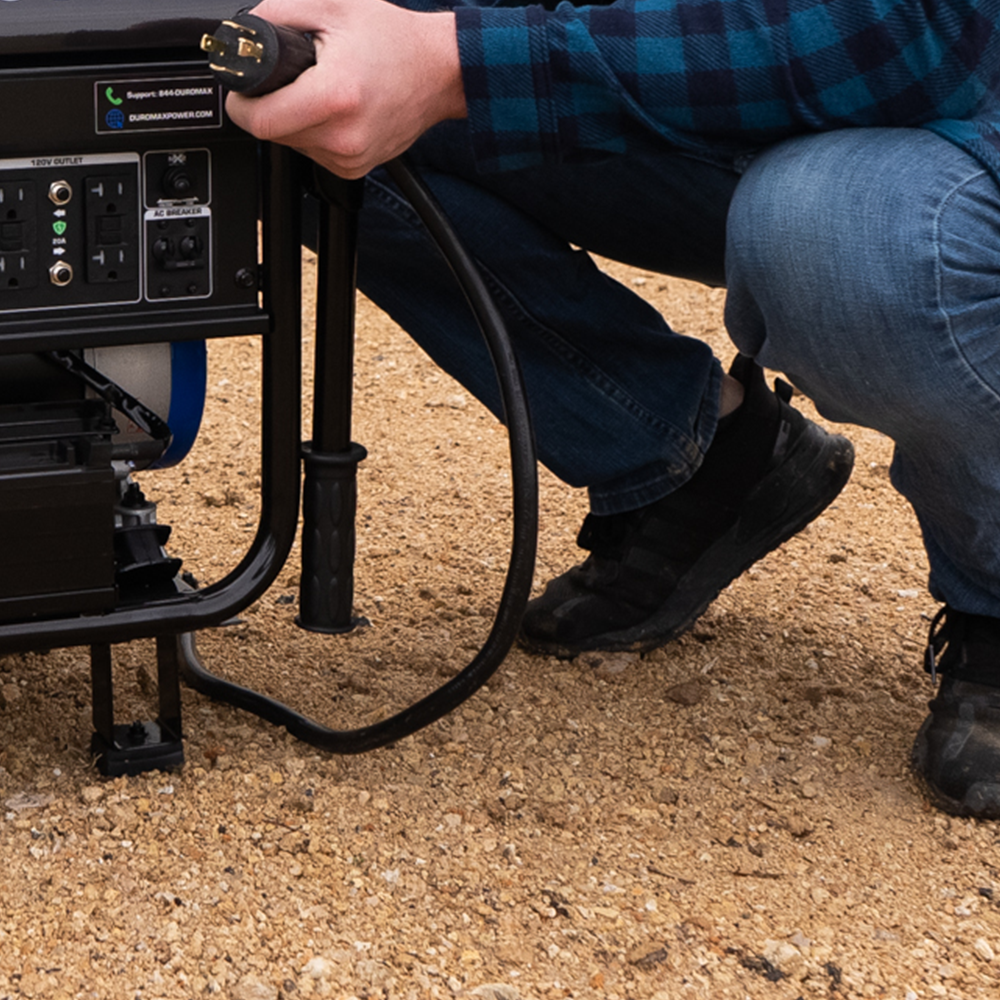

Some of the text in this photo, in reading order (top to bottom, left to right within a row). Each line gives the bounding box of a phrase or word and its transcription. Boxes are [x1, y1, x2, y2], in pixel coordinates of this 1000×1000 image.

[128, 110, 213, 122] DUROMAXPOWER.COM
[31, 157, 83, 166] 120V OUTLET
[154, 207, 202, 218] AC BREAKER
